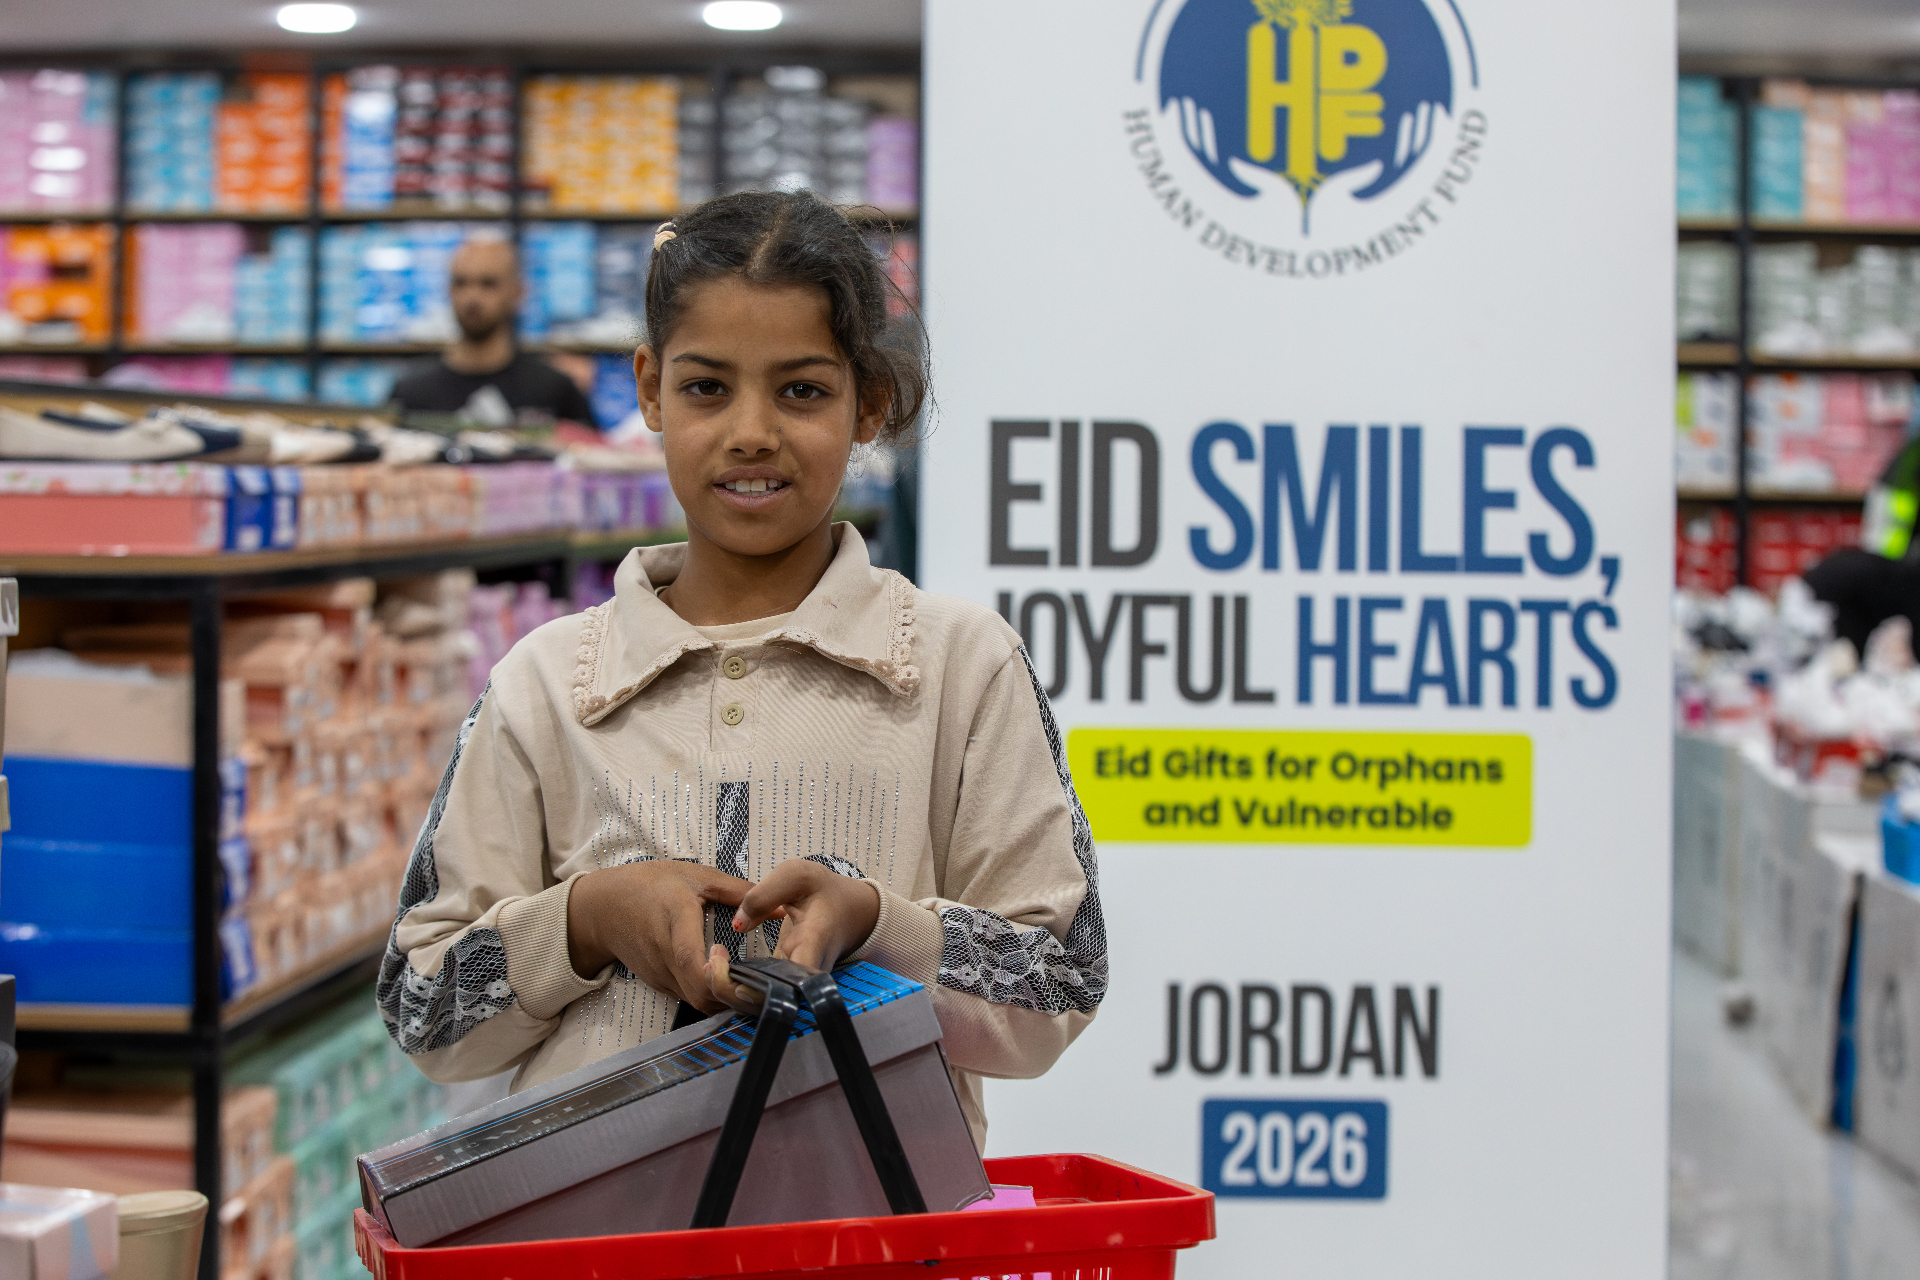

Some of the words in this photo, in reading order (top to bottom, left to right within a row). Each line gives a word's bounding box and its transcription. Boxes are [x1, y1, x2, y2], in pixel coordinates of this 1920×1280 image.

[1123, 108, 1204, 231] HUMAN
[1198, 196, 1440, 279] DEVELOPMENT
[1433, 108, 1489, 206] FUND
[988, 419, 1160, 569] EID
[1187, 420, 1622, 600] SMILES,
[997, 591, 1276, 705] OYFUL
[1296, 595, 1620, 711] HEARTS
[1094, 747, 1152, 780] Eid
[1162, 748, 1254, 782] Gifts
[1265, 748, 1319, 781] for
[1328, 750, 1504, 790] Orphans
[1143, 798, 1221, 827] and
[1232, 799, 1454, 831] Vulnerable
[1153, 982, 1441, 1079] JORDAN
[1221, 1113, 1367, 1186] 2026
